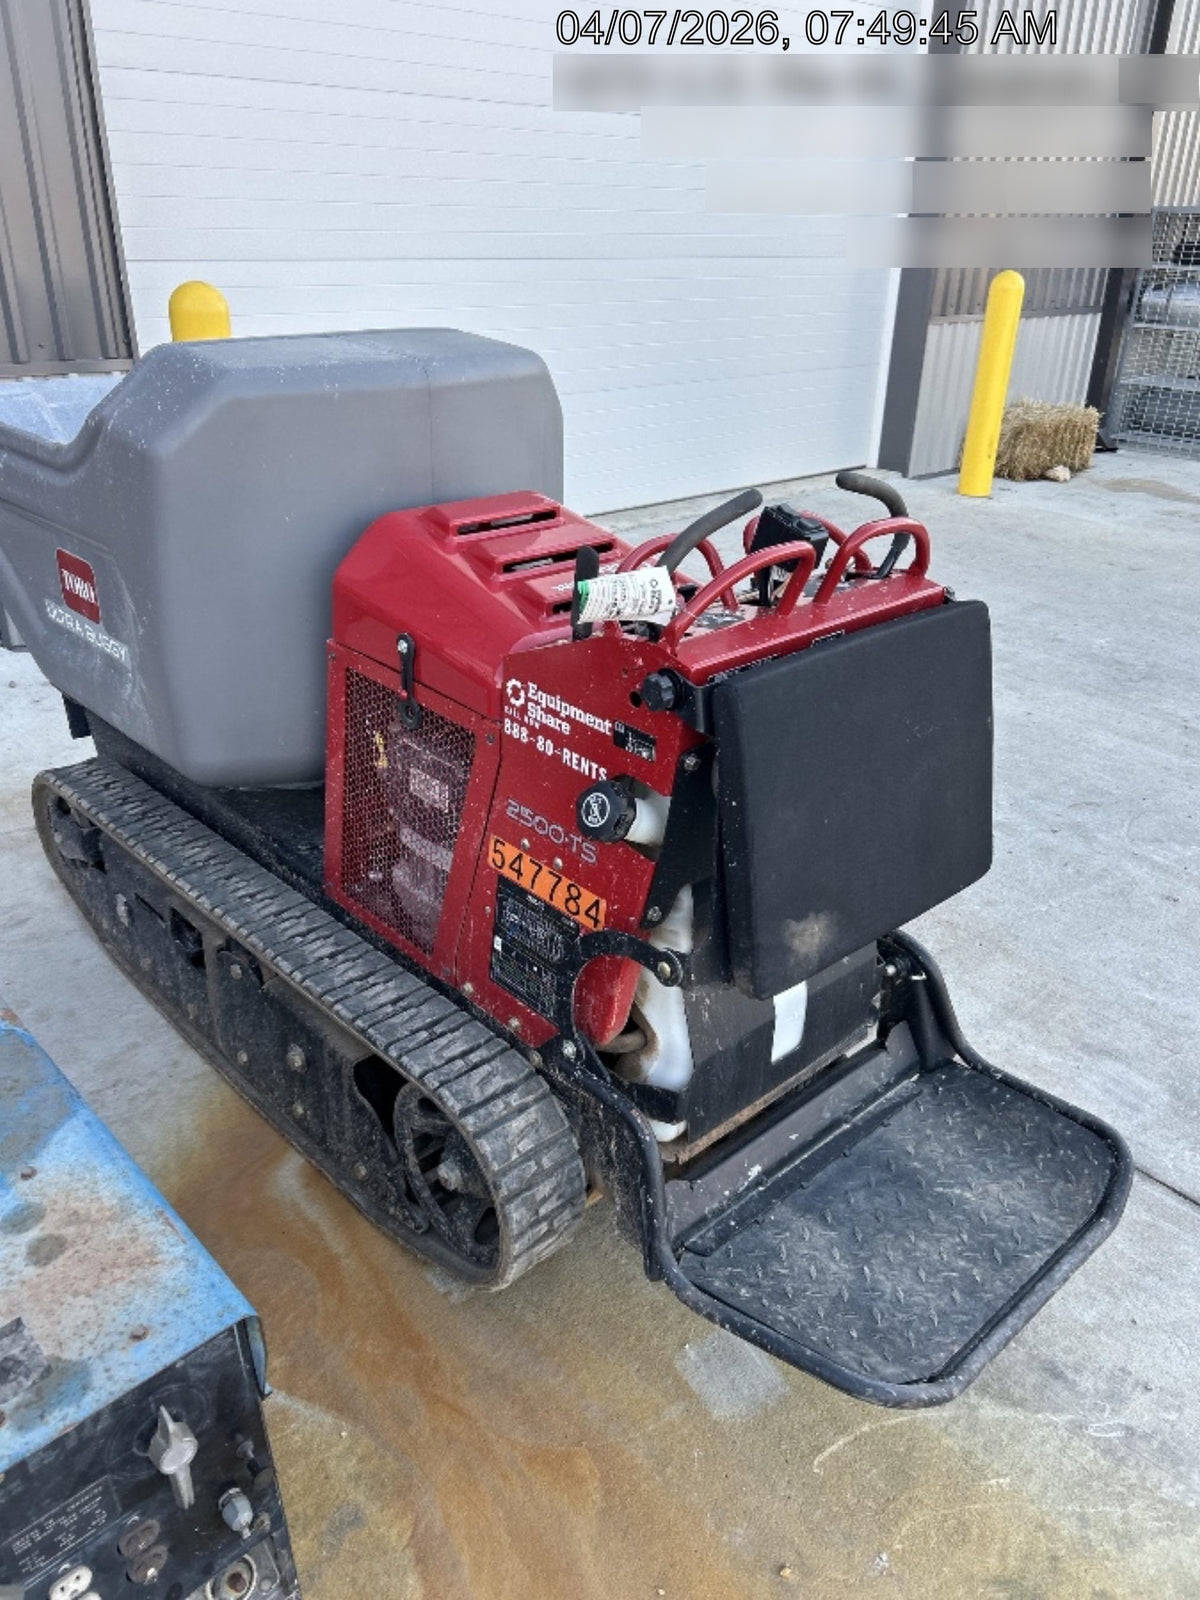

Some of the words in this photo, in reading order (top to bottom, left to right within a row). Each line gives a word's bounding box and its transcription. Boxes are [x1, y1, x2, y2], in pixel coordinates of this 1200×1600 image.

[527, 681, 612, 735] Equipment
[527, 702, 570, 735] Share
[504, 717, 607, 781] 888-80-RENTS
[491, 838, 602, 929] 547784
